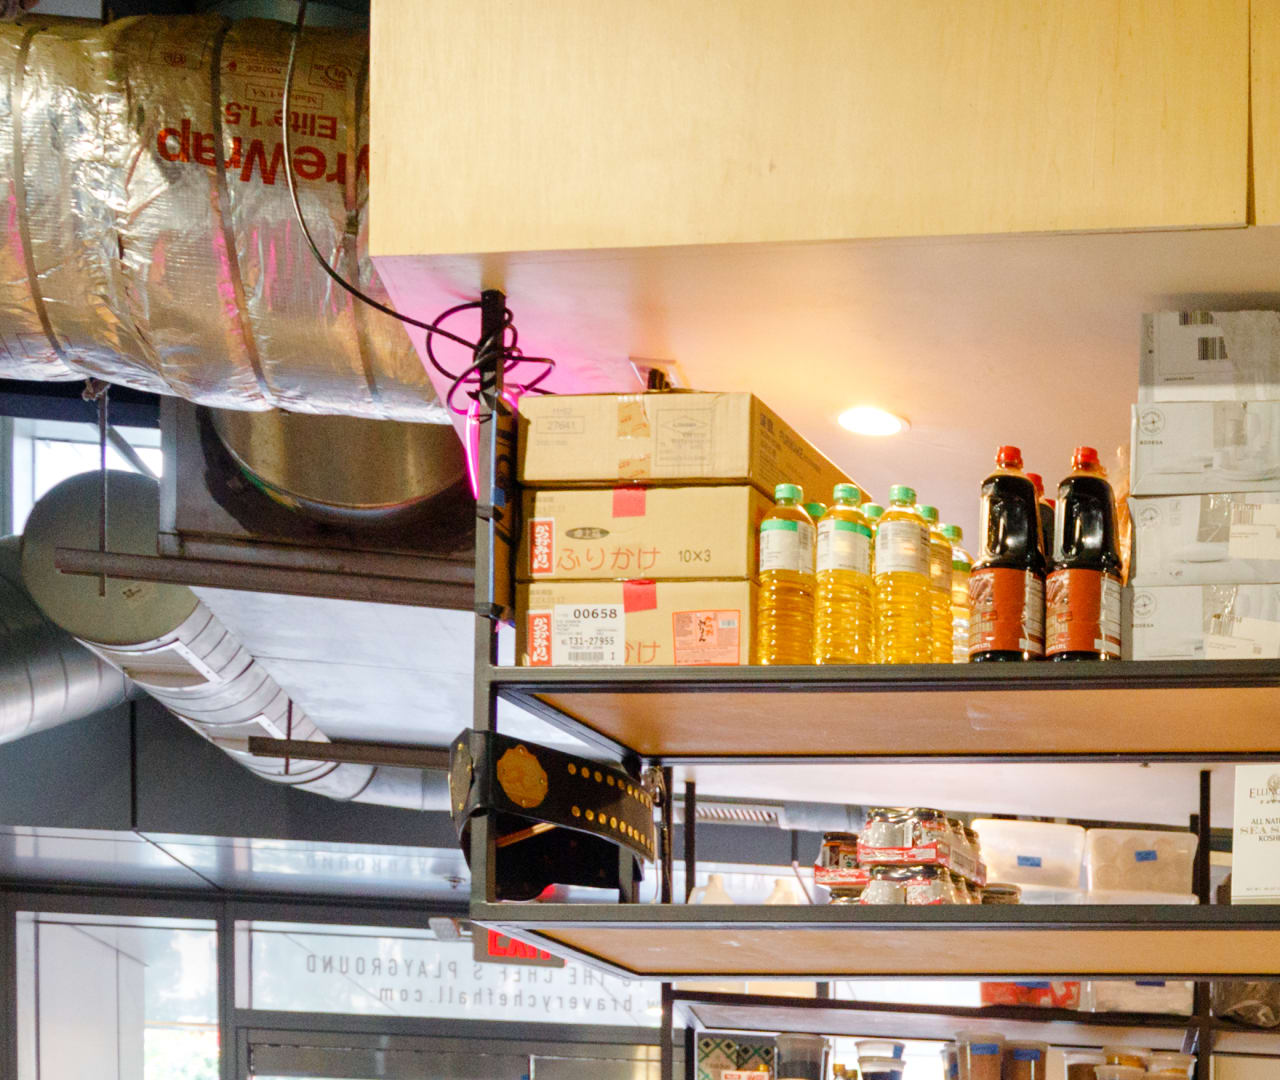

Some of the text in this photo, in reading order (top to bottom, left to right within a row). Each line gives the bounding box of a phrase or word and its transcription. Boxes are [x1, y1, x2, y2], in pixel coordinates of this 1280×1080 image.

[225, 102, 259, 127] 1.5
[556, 547, 661, 572] ふりかけ
[573, 608, 618, 619] 00658
[1240, 826, 1268, 834] SEA
